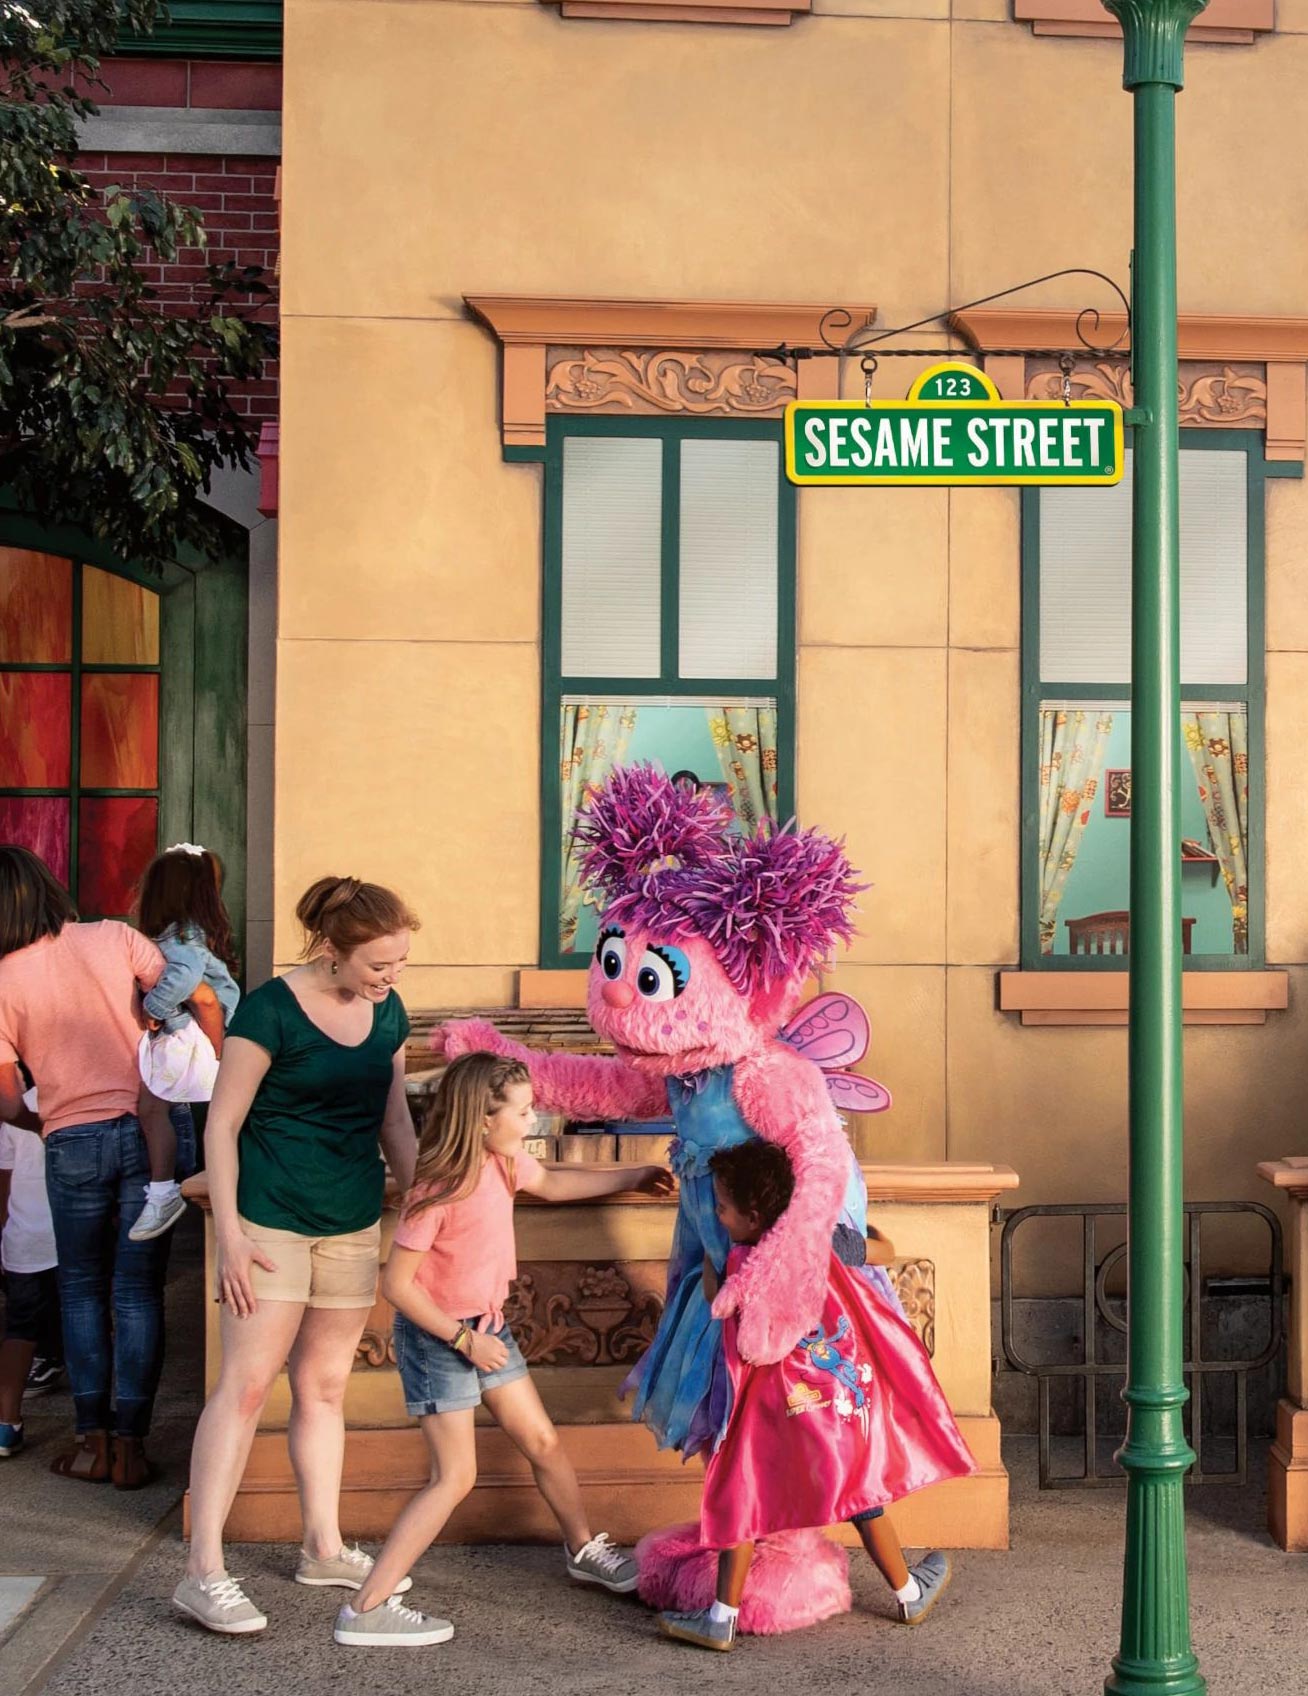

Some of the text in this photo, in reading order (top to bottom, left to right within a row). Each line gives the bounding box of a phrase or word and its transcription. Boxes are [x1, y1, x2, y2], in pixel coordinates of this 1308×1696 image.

[935, 378, 971, 397] 123
[804, 417, 1105, 467] SESAME STREET
